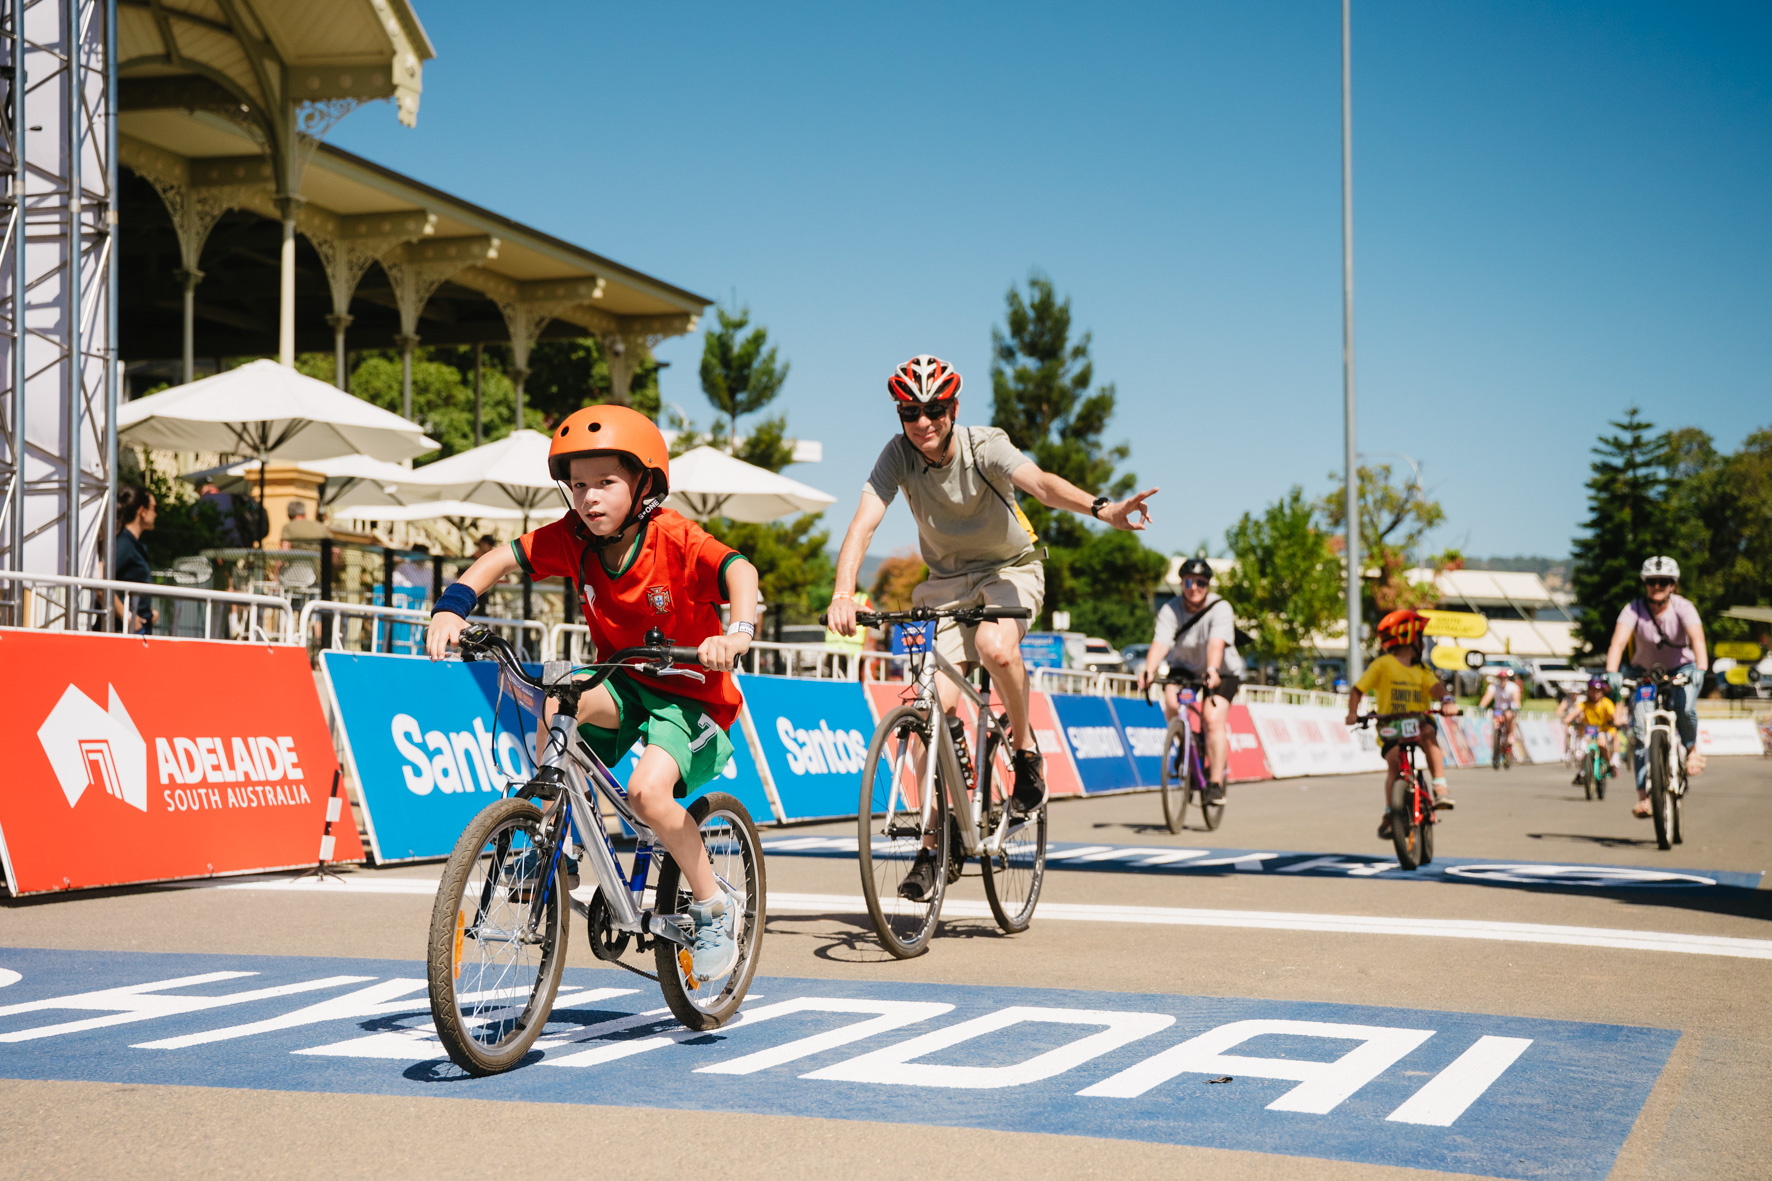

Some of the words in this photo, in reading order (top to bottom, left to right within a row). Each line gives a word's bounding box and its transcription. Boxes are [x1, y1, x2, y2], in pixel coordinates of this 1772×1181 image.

[688, 713, 718, 753] 7
[776, 716, 868, 776] Santos
[155, 736, 304, 784] ADELAIDE
[163, 787, 223, 812] SOUTH
[227, 784, 311, 808] AUSTRALIA
